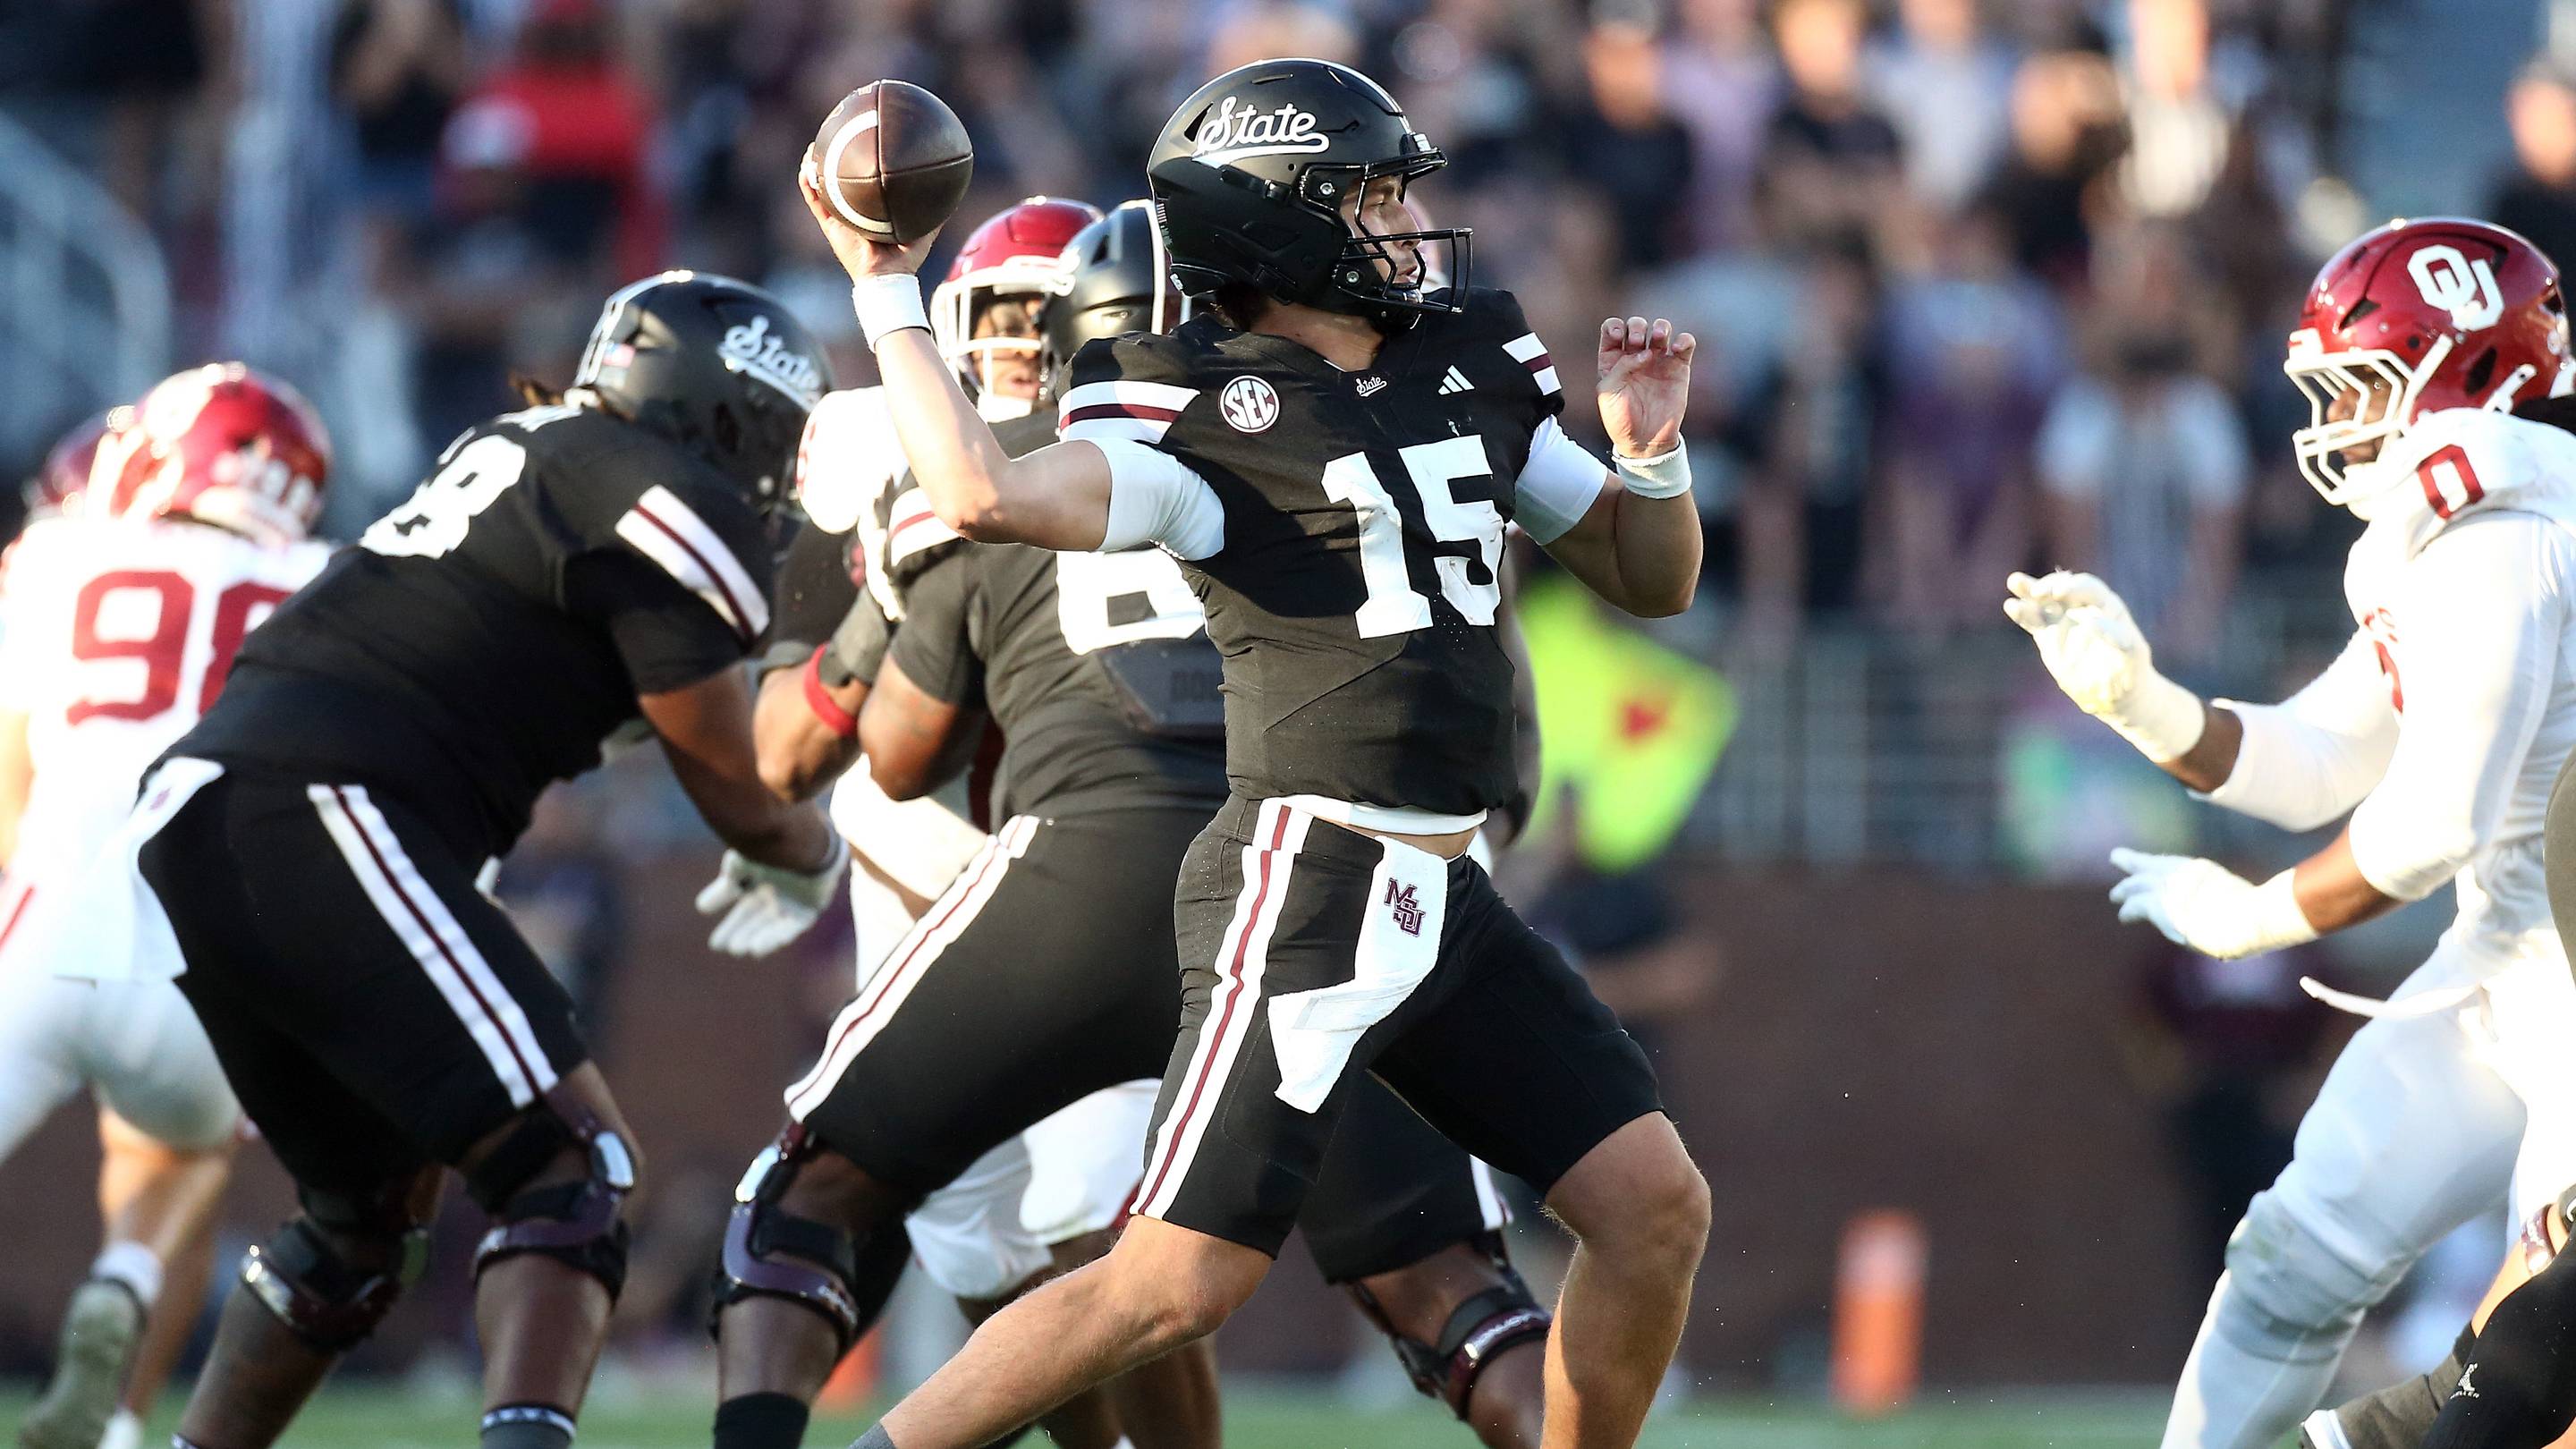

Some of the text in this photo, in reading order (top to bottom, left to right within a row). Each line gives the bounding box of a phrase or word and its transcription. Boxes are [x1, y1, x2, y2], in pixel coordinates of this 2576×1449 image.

[1192, 96, 1329, 166] State
[2407, 244, 2504, 332] OU
[1224, 378, 1276, 430] SEC
[1356, 375, 1387, 398] State
[1320, 434, 1504, 640] 15
[1384, 877, 1427, 938] MSU
